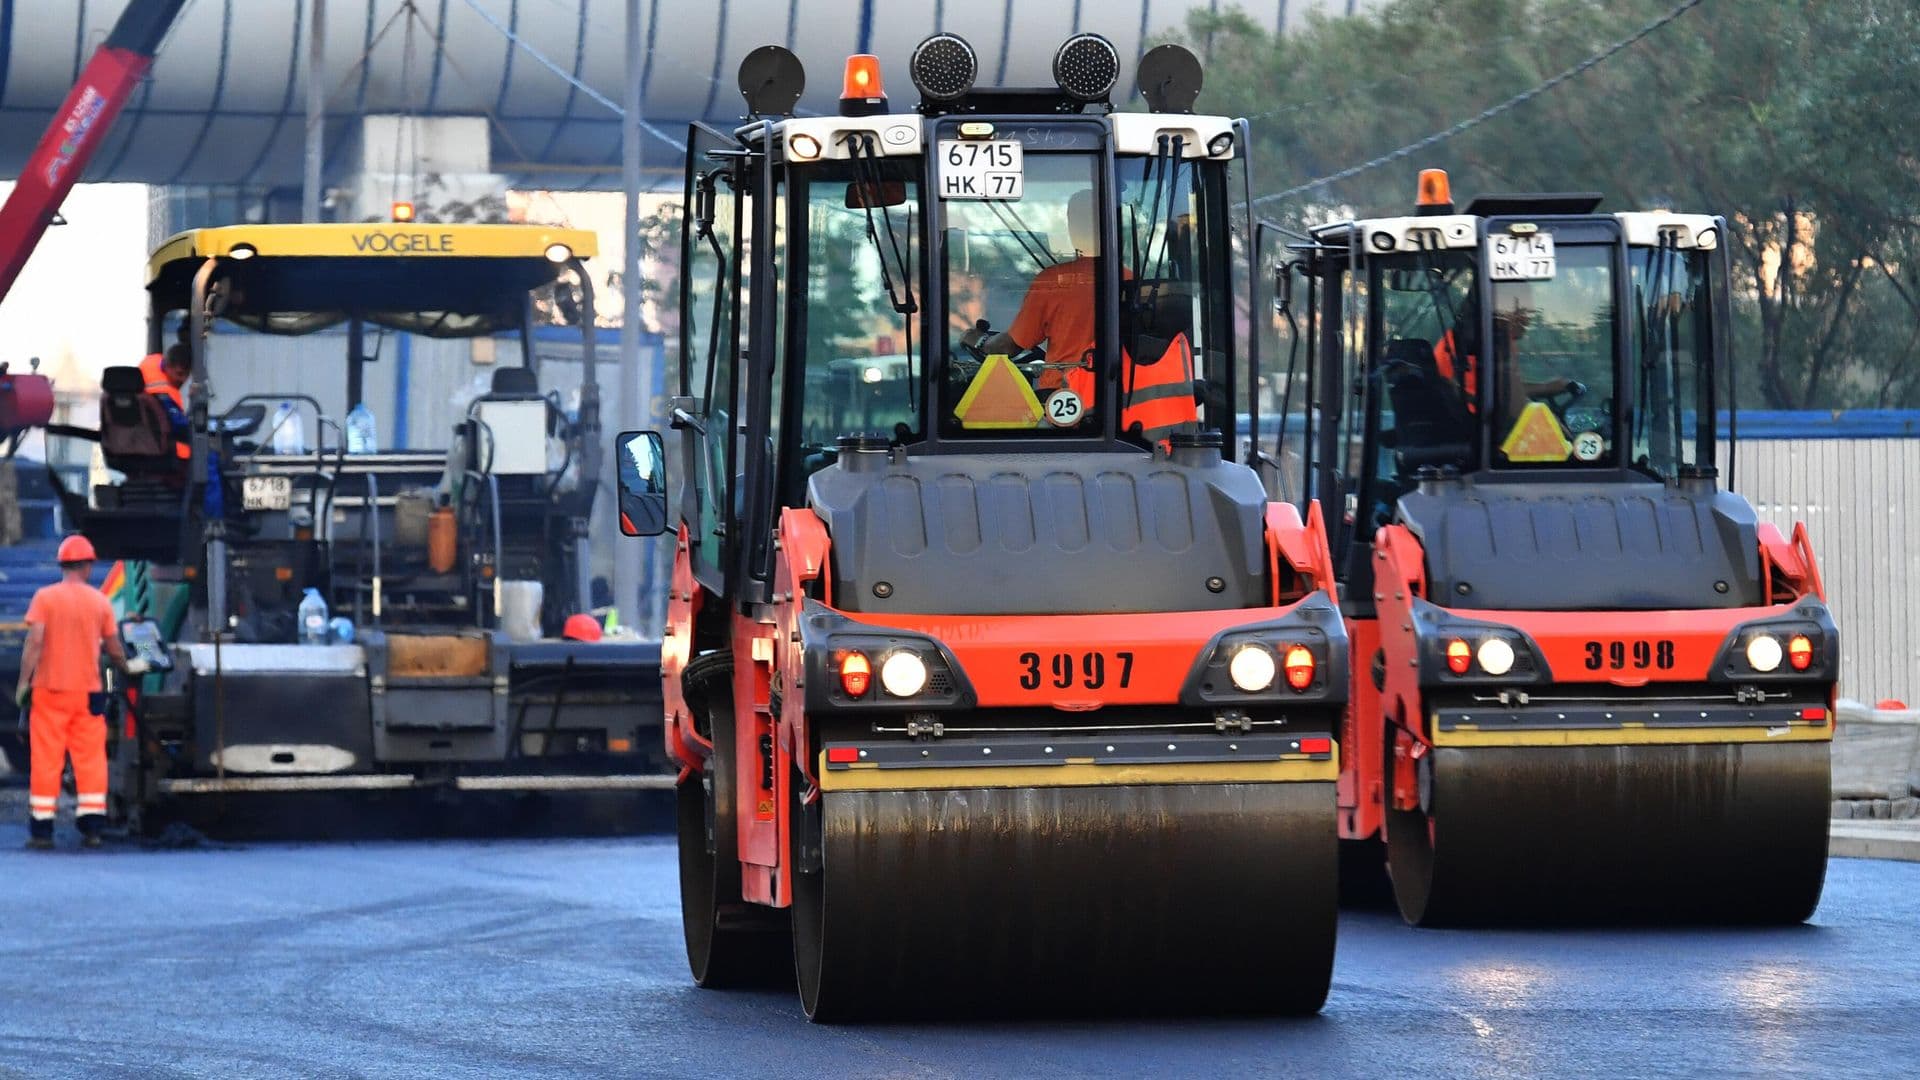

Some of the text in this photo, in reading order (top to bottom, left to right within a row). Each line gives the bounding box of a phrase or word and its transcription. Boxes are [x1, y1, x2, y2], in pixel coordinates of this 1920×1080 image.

[948, 144, 1012, 167] 6715
[992, 176, 1016, 194] 77
[352, 229, 454, 252] VÖGELE
[1496, 235, 1546, 254] 6714
[1530, 260, 1549, 275] 77
[1052, 397, 1077, 417] 25
[1581, 440, 1597, 455] 25
[1585, 640, 1674, 670] 3998
[1019, 652, 1133, 690] 3997
